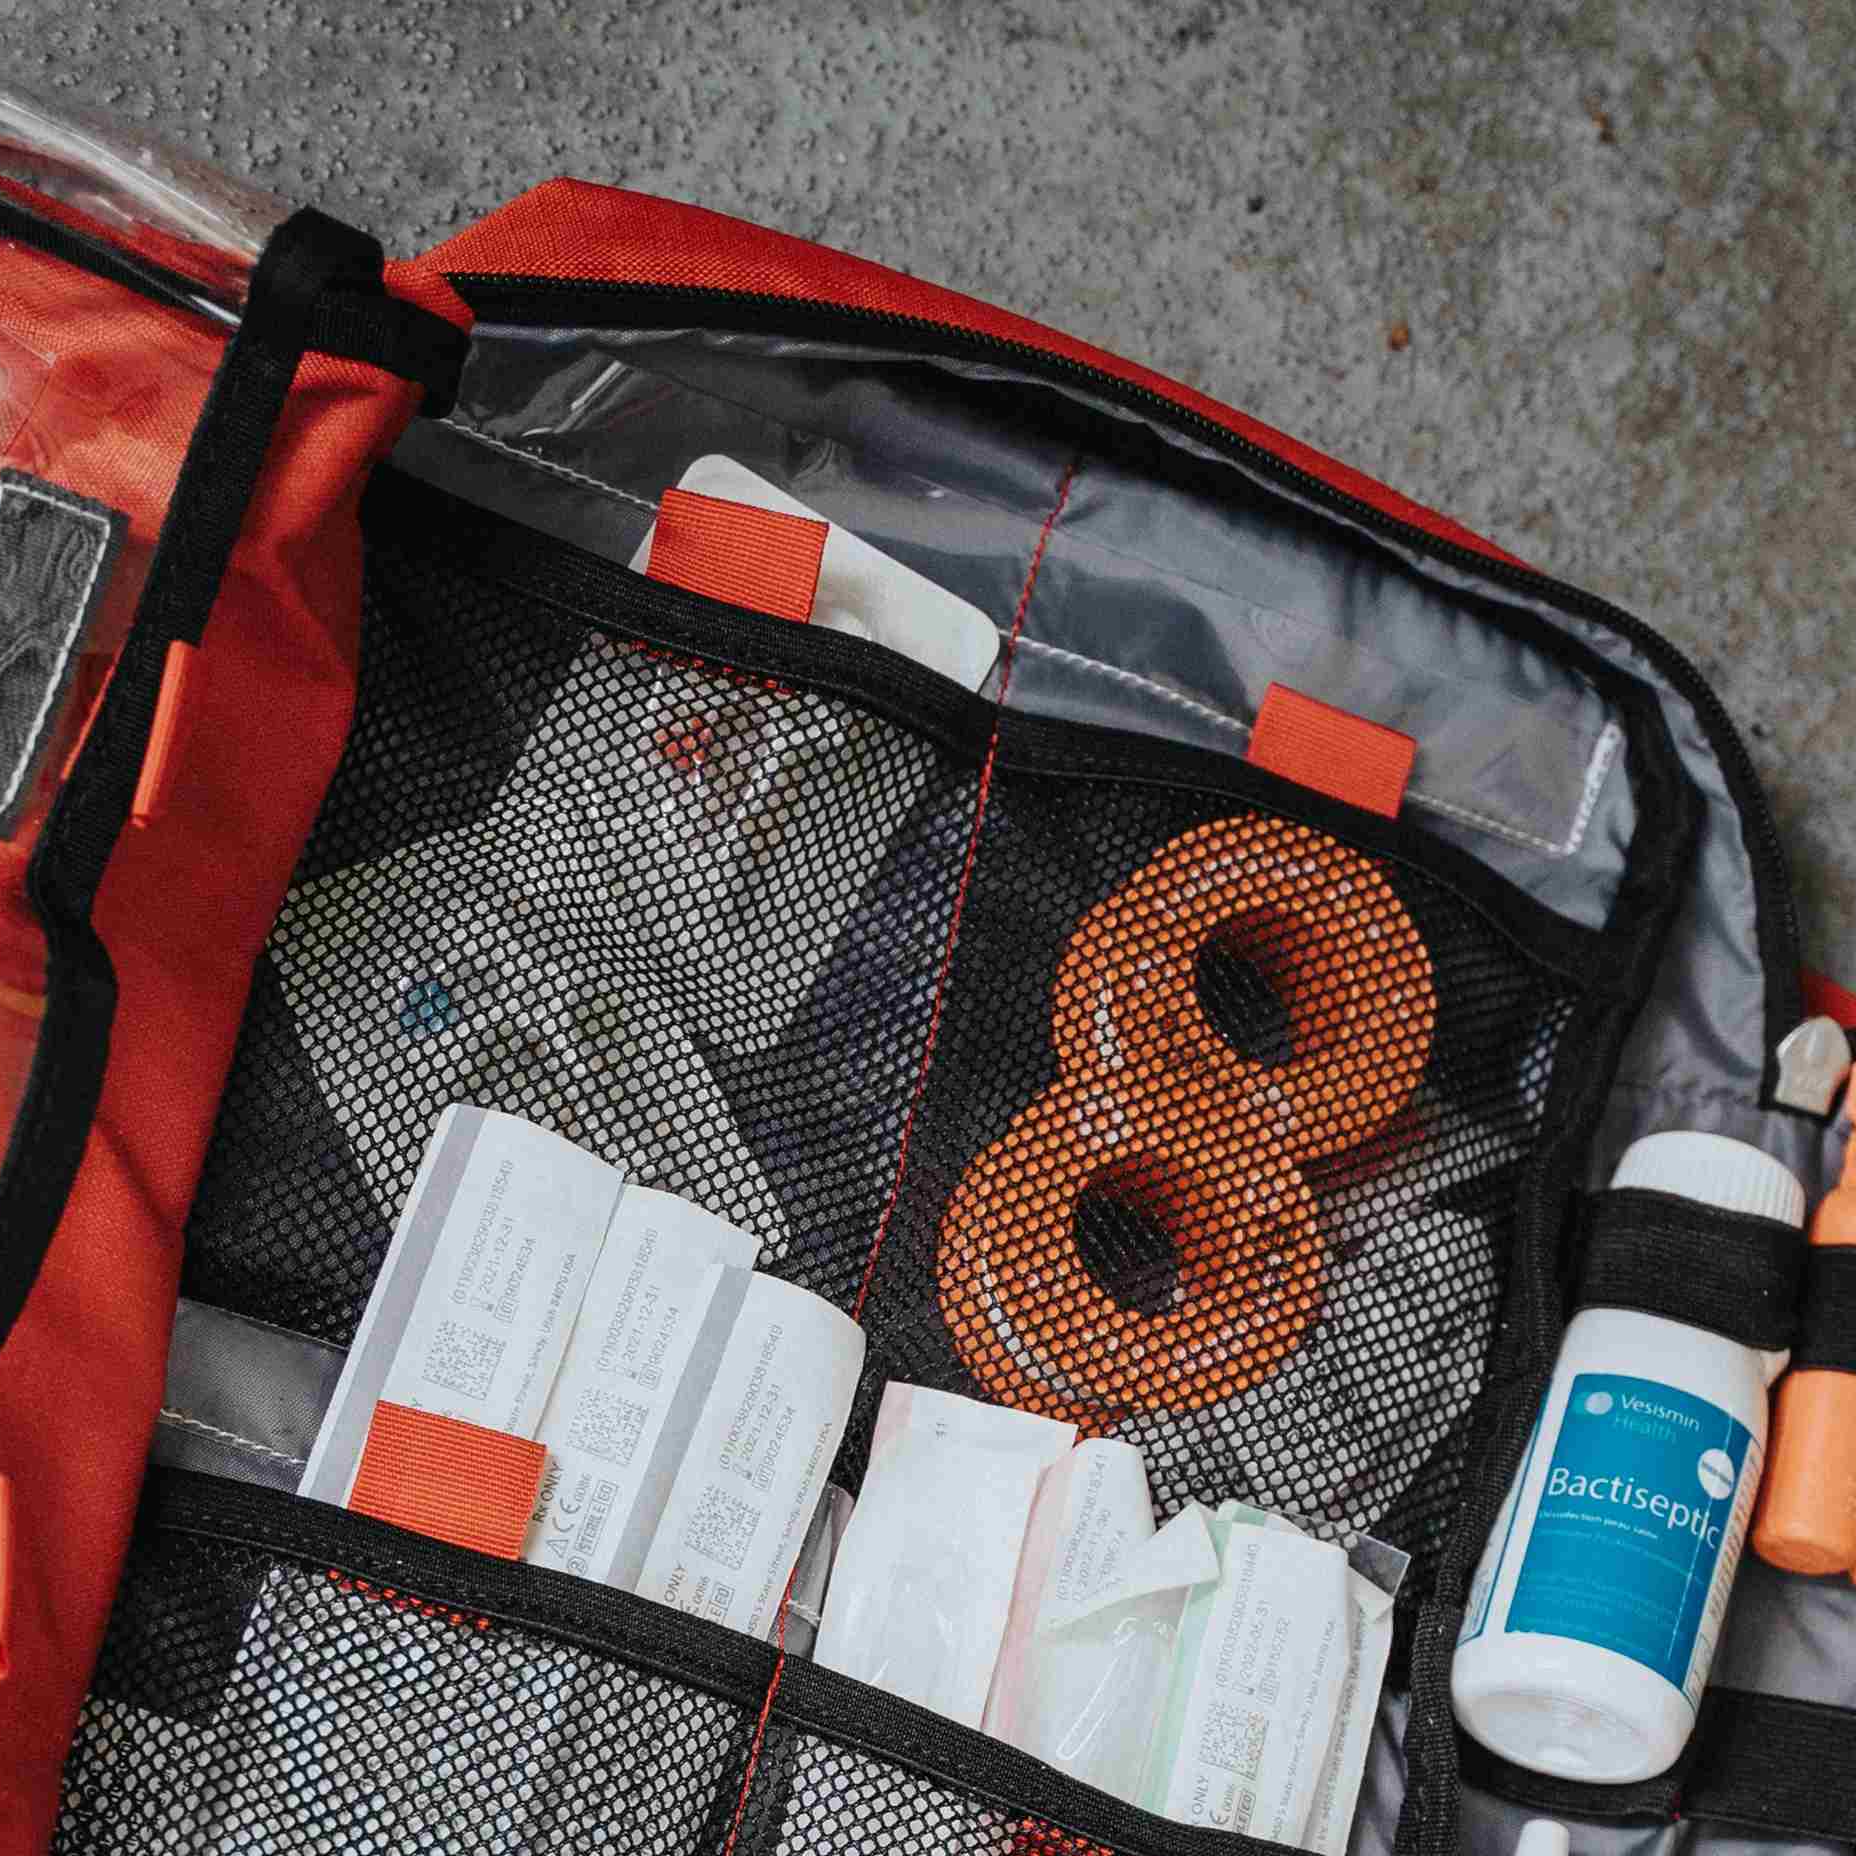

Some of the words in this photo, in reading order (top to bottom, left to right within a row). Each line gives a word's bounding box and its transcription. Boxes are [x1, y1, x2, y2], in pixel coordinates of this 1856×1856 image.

[622, 1284, 661, 1363] 2021-12-31
[1614, 1415, 1678, 1443] Health
[1621, 1394, 1701, 1433] Vesismin
[540, 1462, 564, 1502] ONLY
[577, 1504, 607, 1551] STERILE
[1547, 1467, 1721, 1549] Bactiseptic
[664, 1560, 685, 1602] ONLY
[1191, 1775, 1208, 1815] ONLY
